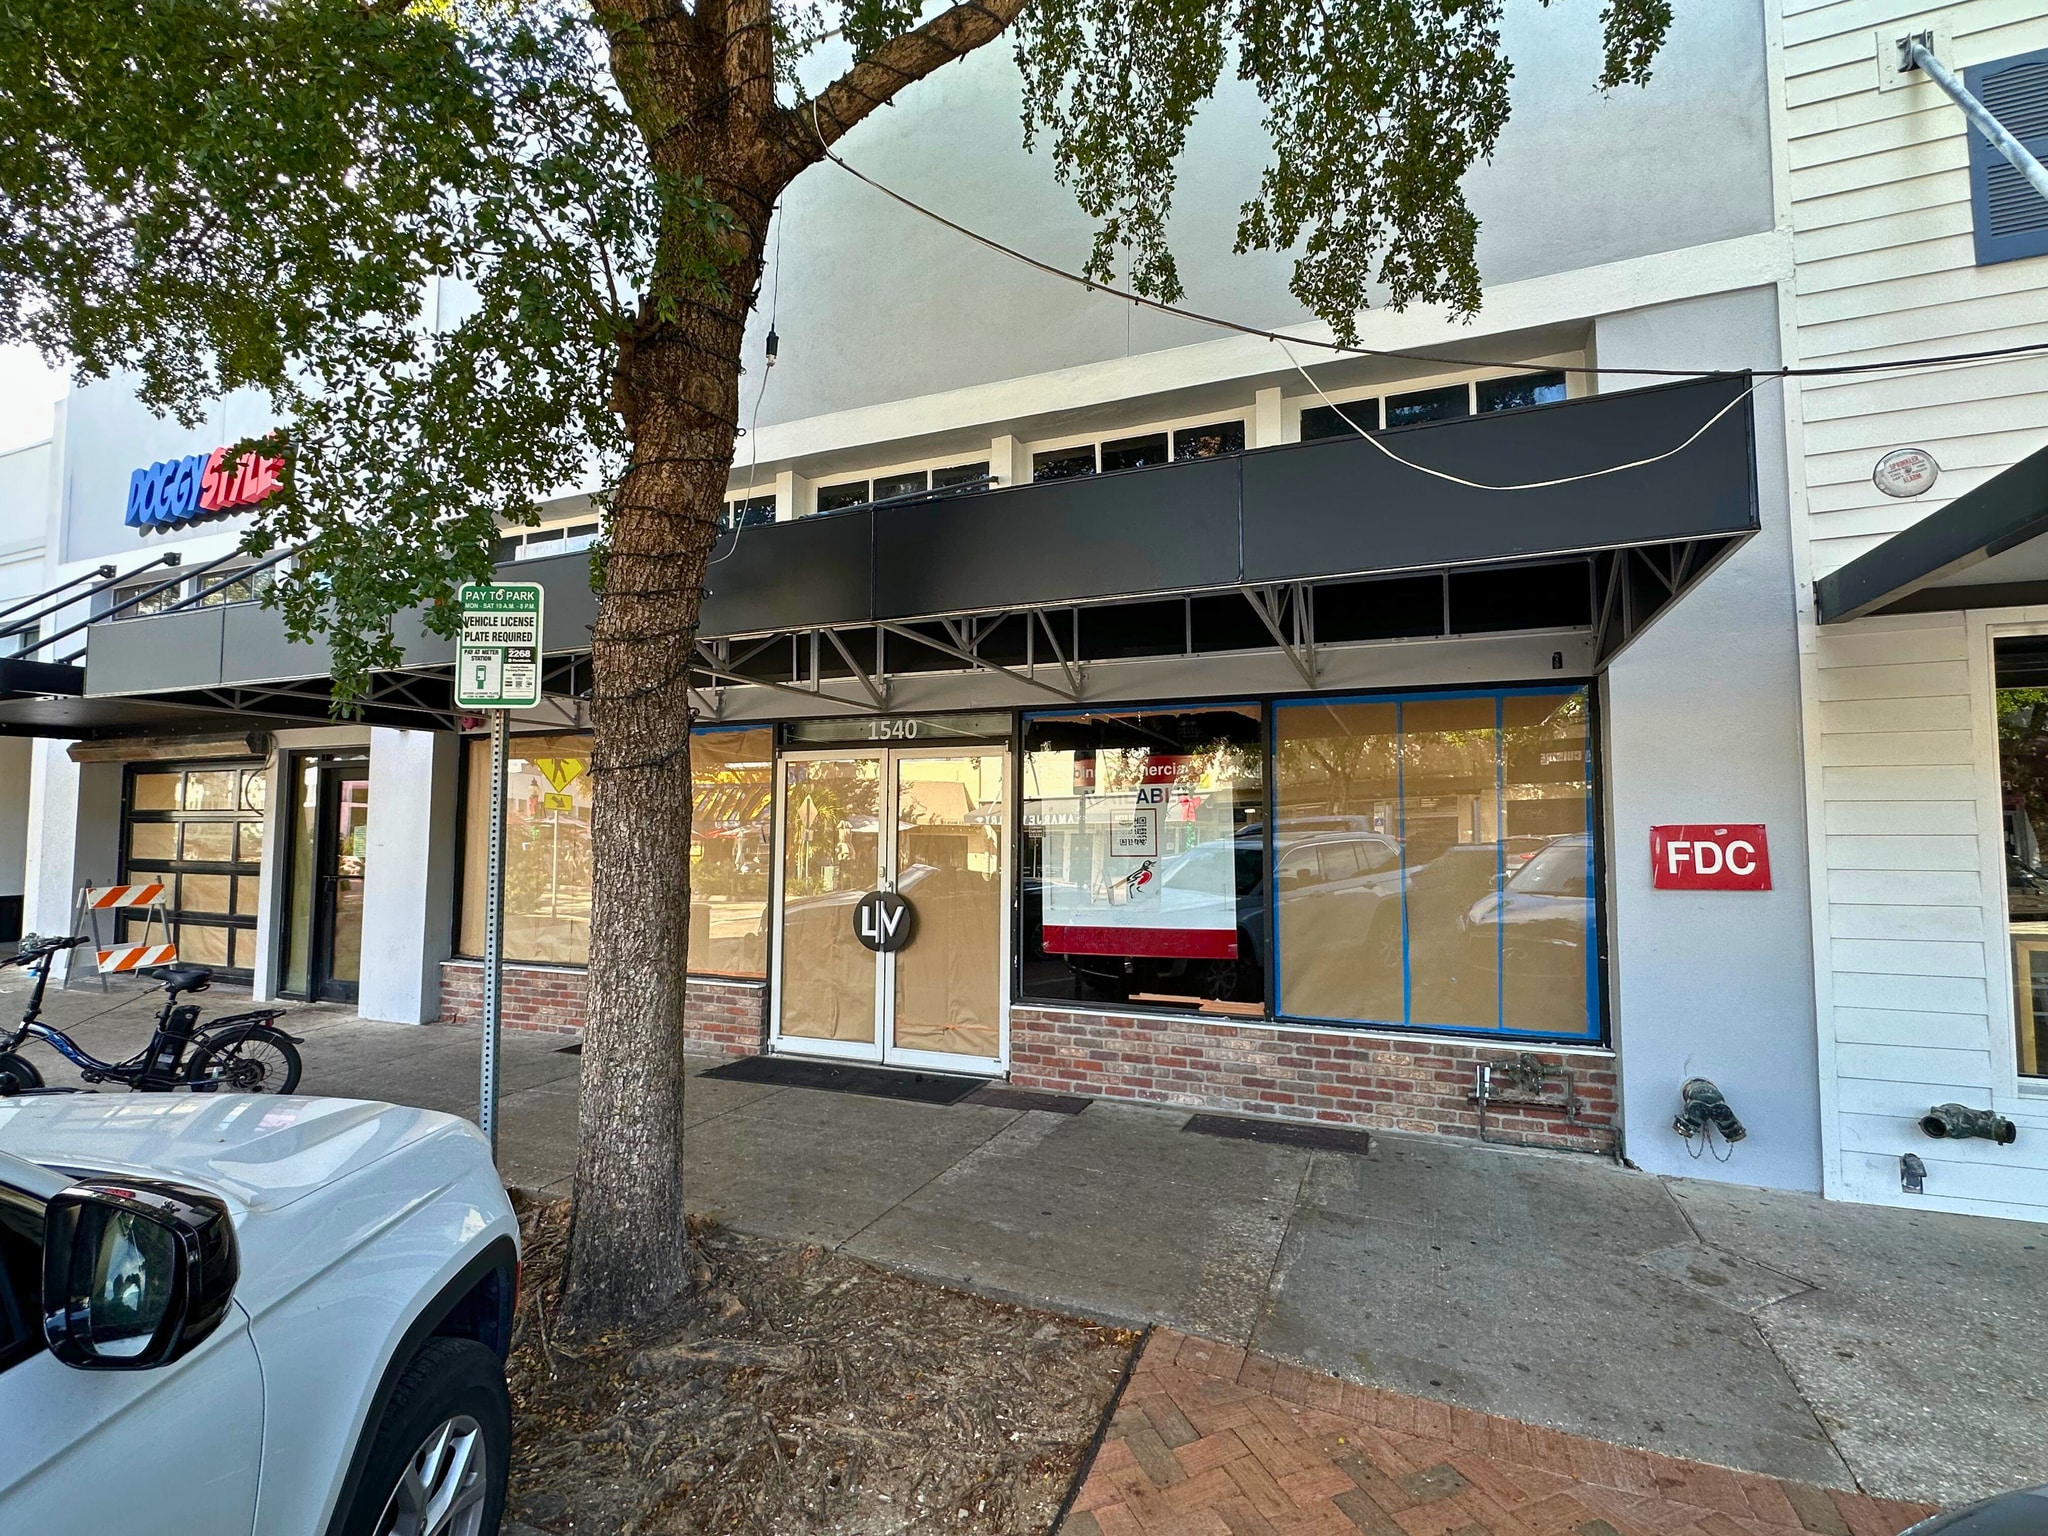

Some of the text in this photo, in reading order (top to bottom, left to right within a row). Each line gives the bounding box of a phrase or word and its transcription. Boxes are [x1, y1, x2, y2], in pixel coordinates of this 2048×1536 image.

[465, 591, 535, 601] PAY TO PARK
[464, 616, 535, 627] VEHICLE LICENSE
[464, 631, 533, 643] PLATE REQUIRED
[507, 649, 531, 658] 2268
[867, 719, 918, 741] 1540
[1667, 840, 1757, 875] FDC
